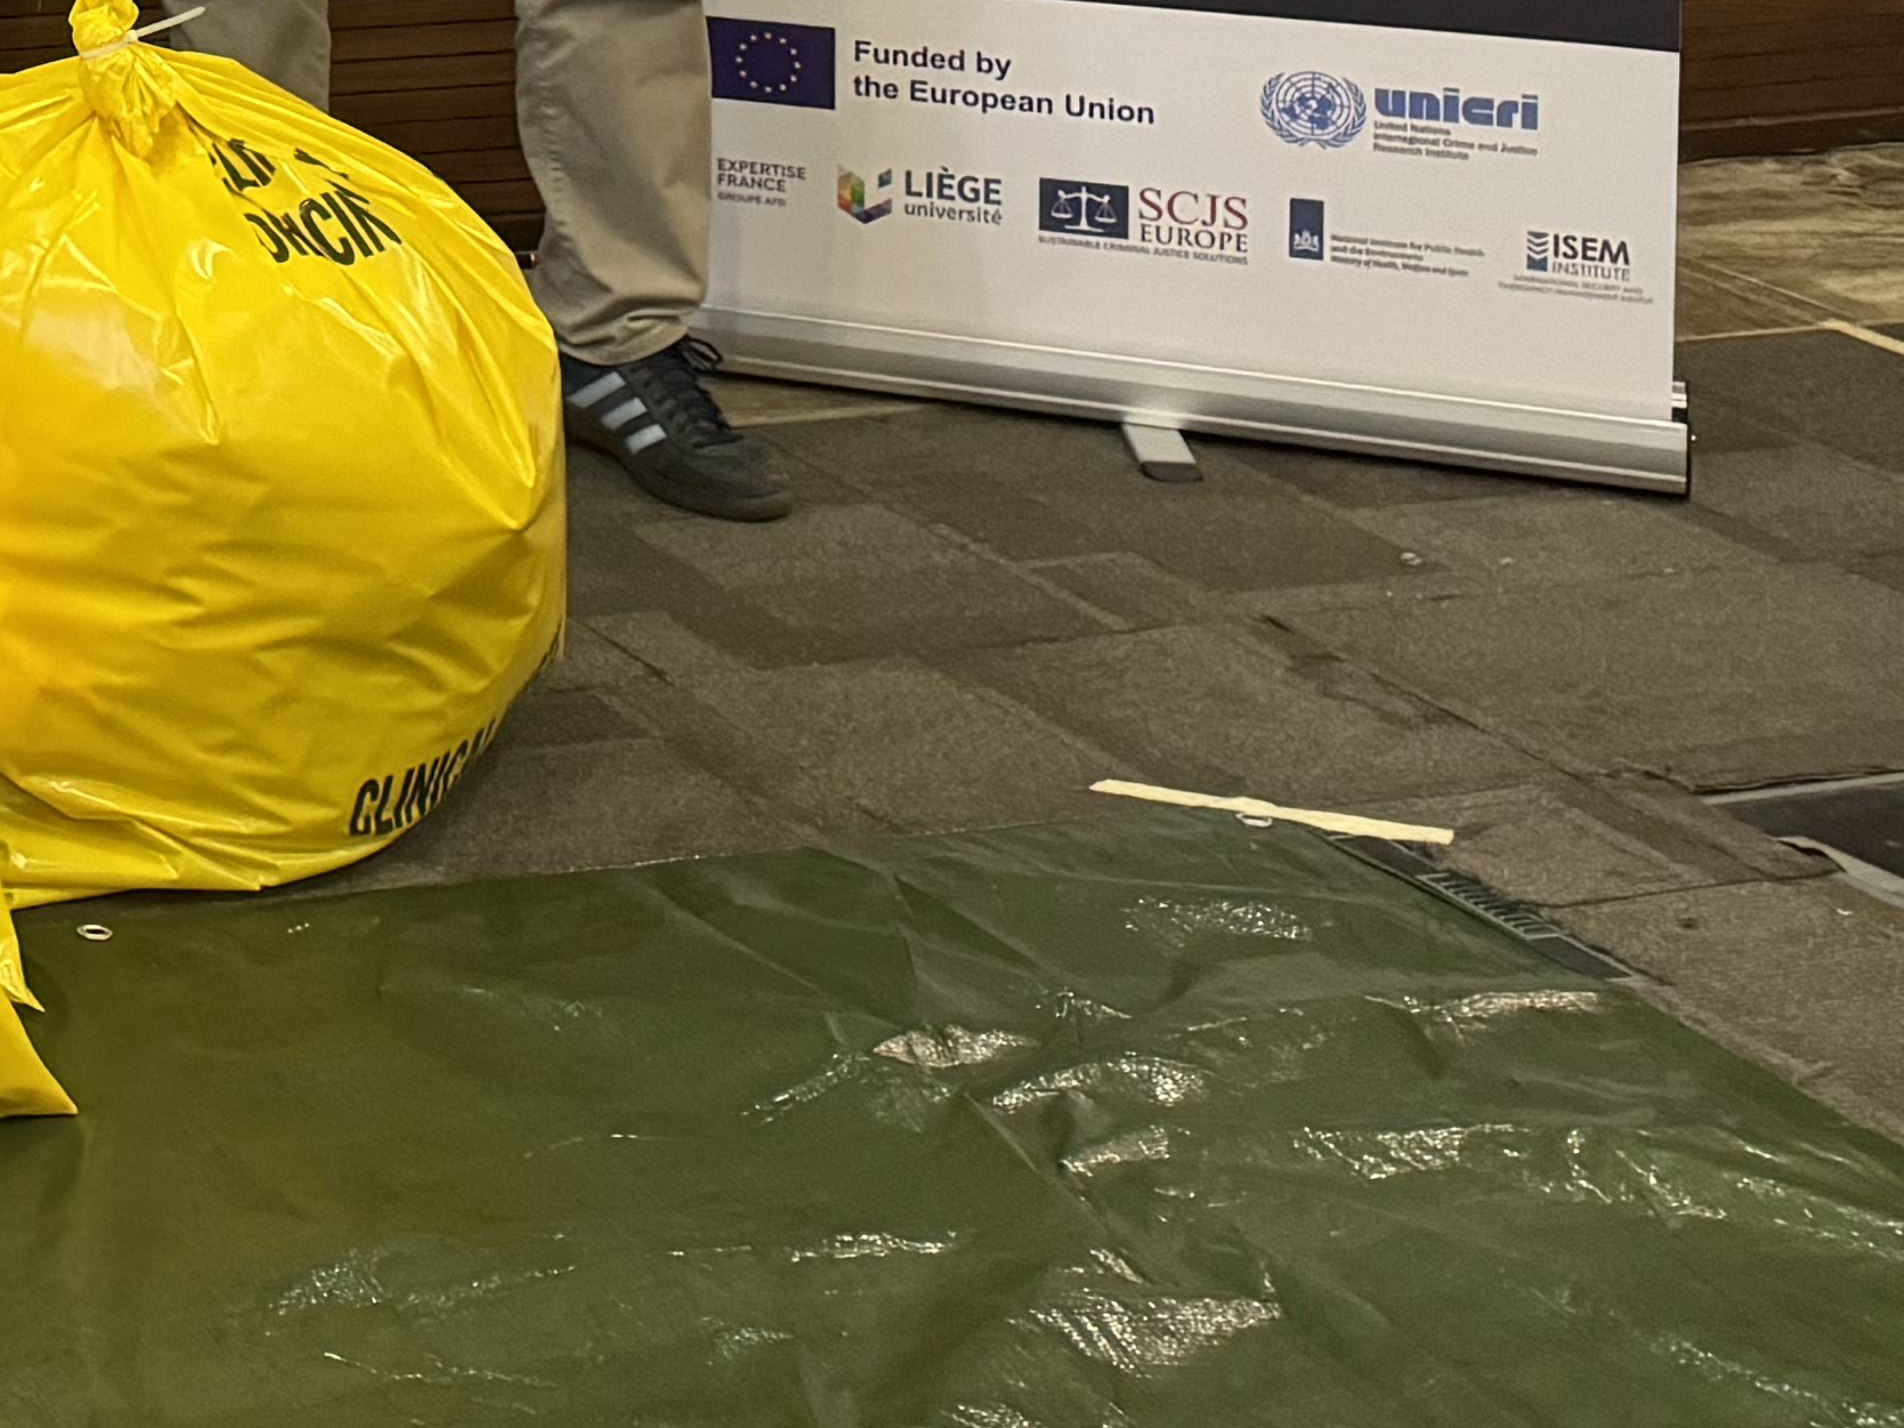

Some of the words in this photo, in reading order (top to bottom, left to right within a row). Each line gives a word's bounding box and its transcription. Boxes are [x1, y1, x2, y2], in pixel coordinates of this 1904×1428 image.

[854, 40, 966, 73] Funded
[975, 51, 1012, 80] by
[854, 75, 900, 100] the
[909, 80, 1054, 115] European
[1064, 94, 1156, 125] Union
[1374, 87, 1539, 131] unicri
[717, 157, 806, 180] EXPERTISE
[717, 173, 787, 193] FRANCE
[904, 166, 1003, 206] LIÈGE
[904, 201, 1003, 226] université
[1138, 187, 1249, 231] SCJS
[1140, 223, 1249, 254] EUROPE
[1553, 233, 1630, 266] ISEM
[1552, 261, 1630, 282] INSTITUTE
